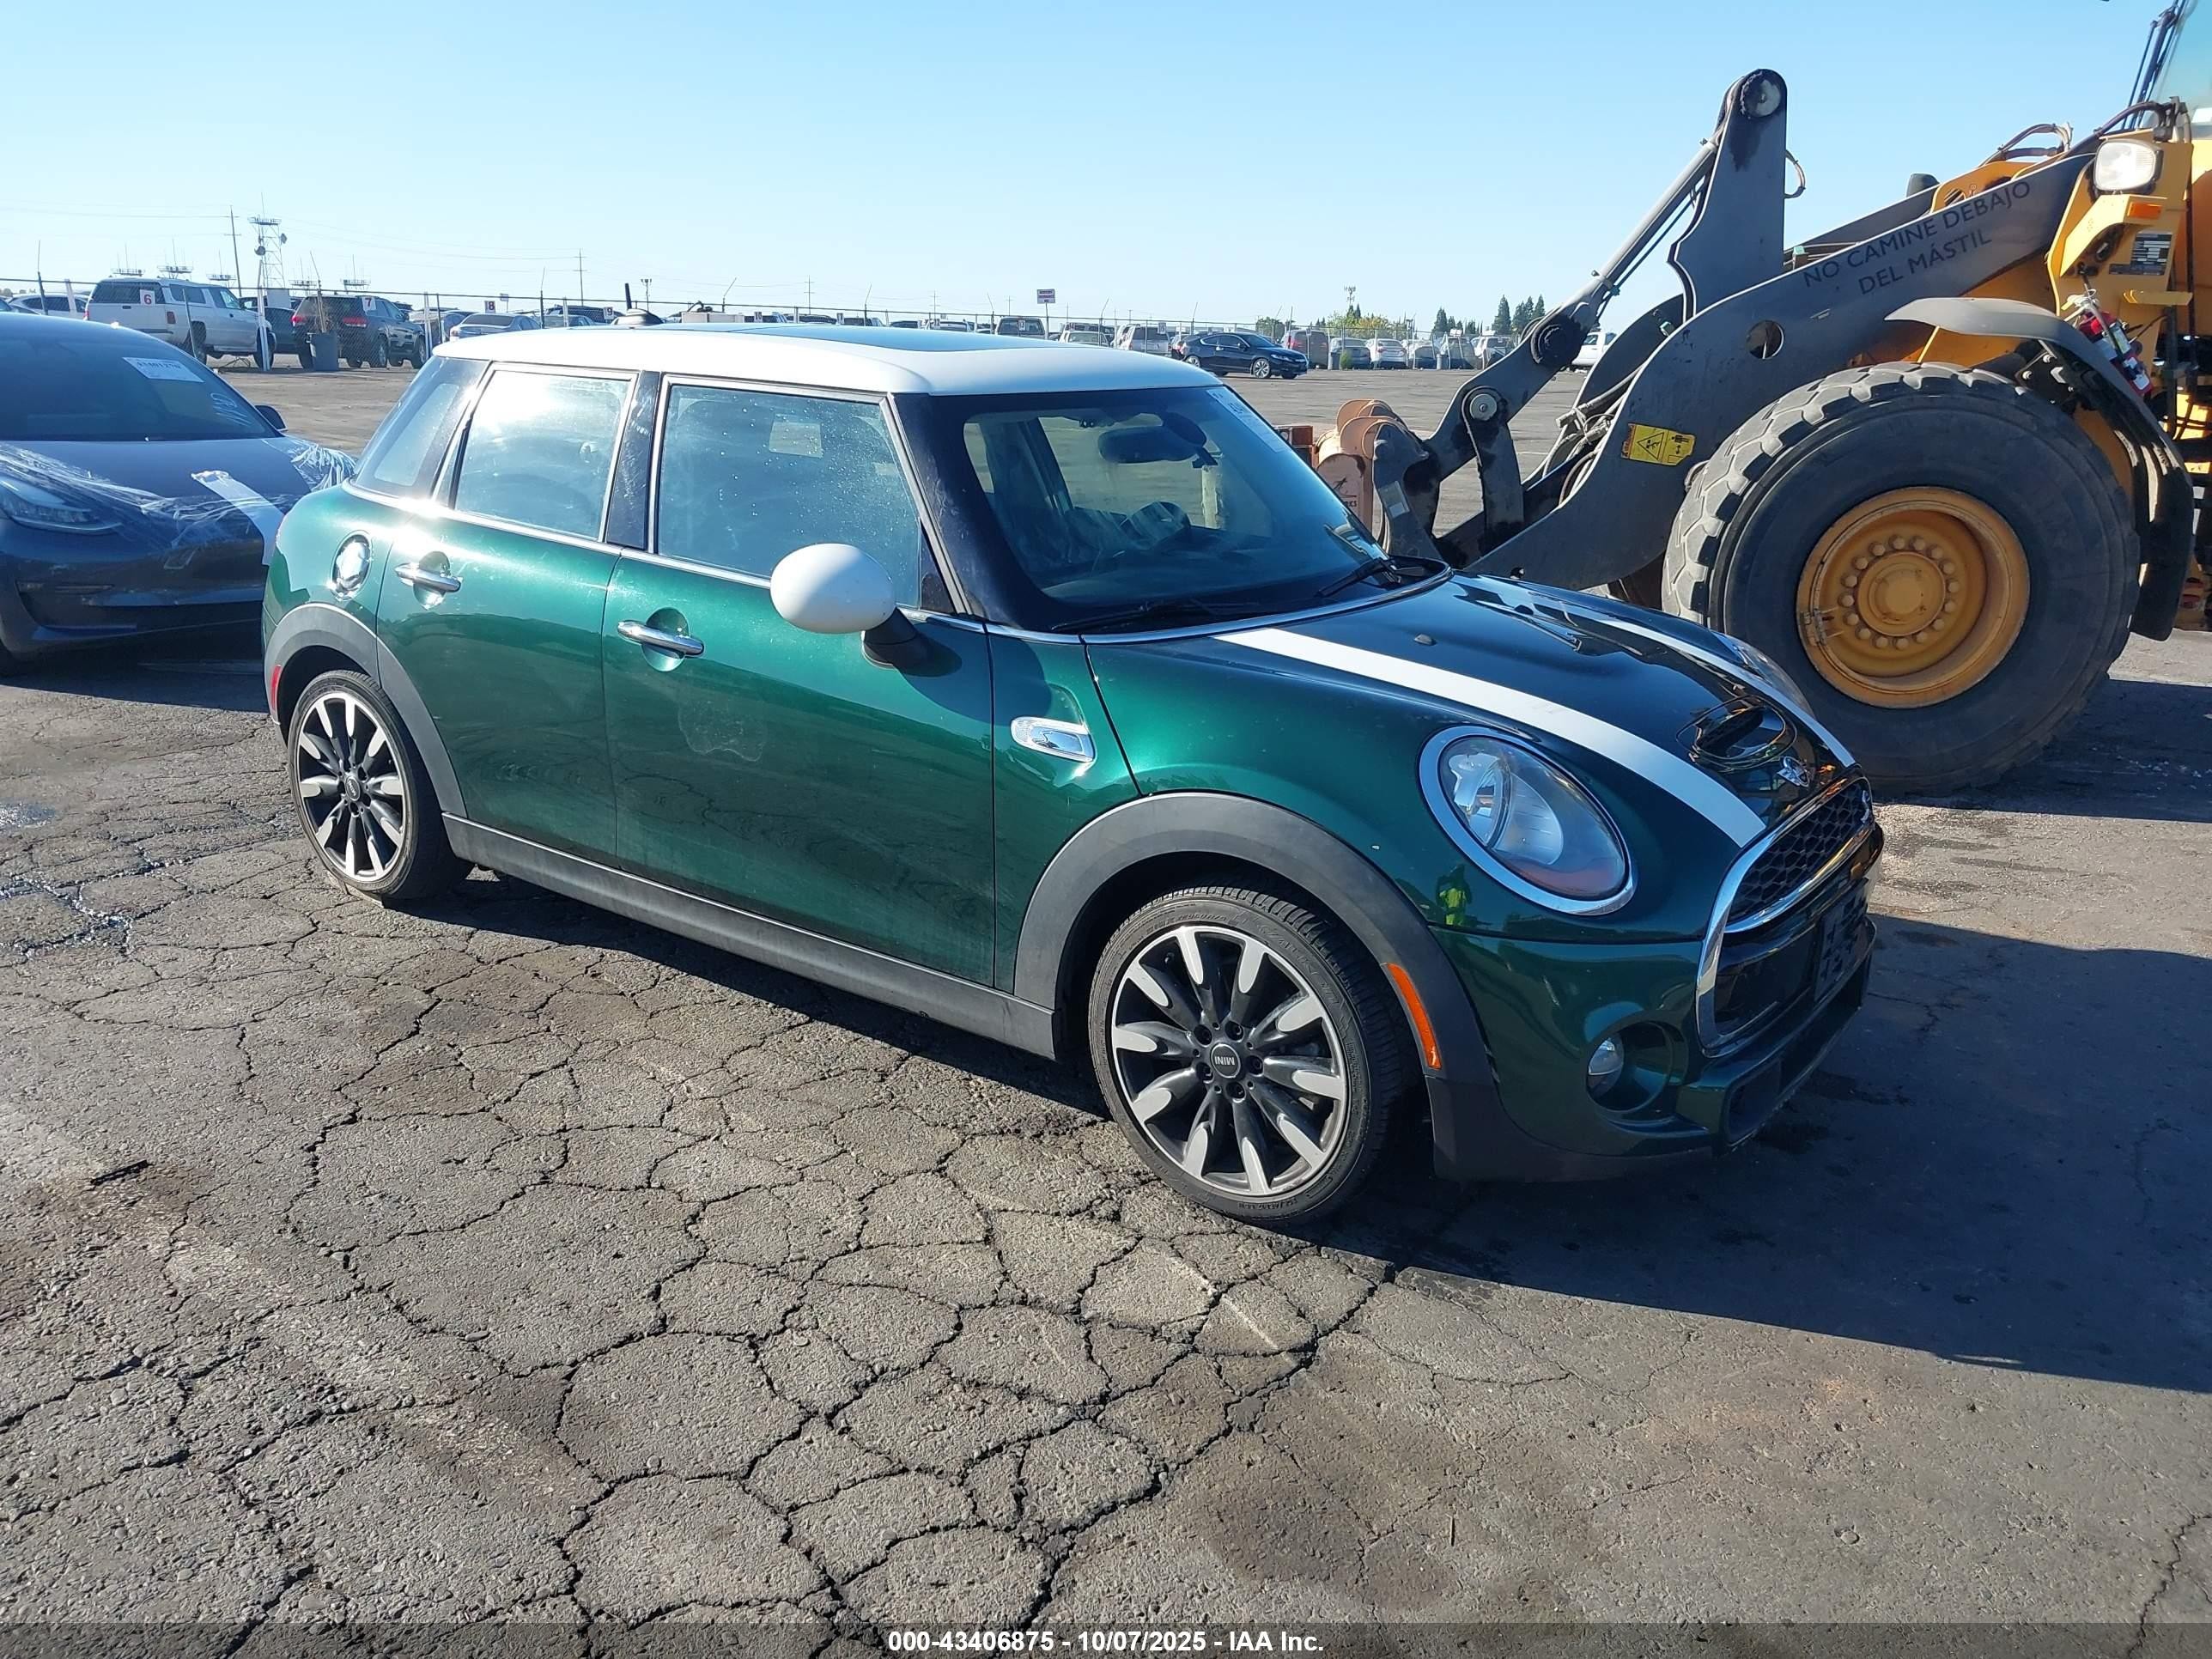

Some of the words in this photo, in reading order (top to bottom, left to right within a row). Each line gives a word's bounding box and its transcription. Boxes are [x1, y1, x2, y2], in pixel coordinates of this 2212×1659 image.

[1803, 263, 1840, 288] NO
[1847, 221, 1938, 269] CAMINE
[1943, 181, 2031, 230] DEBAJO
[1858, 266, 1904, 295] DEL
[1910, 230, 1992, 274] MÁSTIL
[143, 294, 152, 305] 6
[1214, 1056, 1235, 1065] MINI
